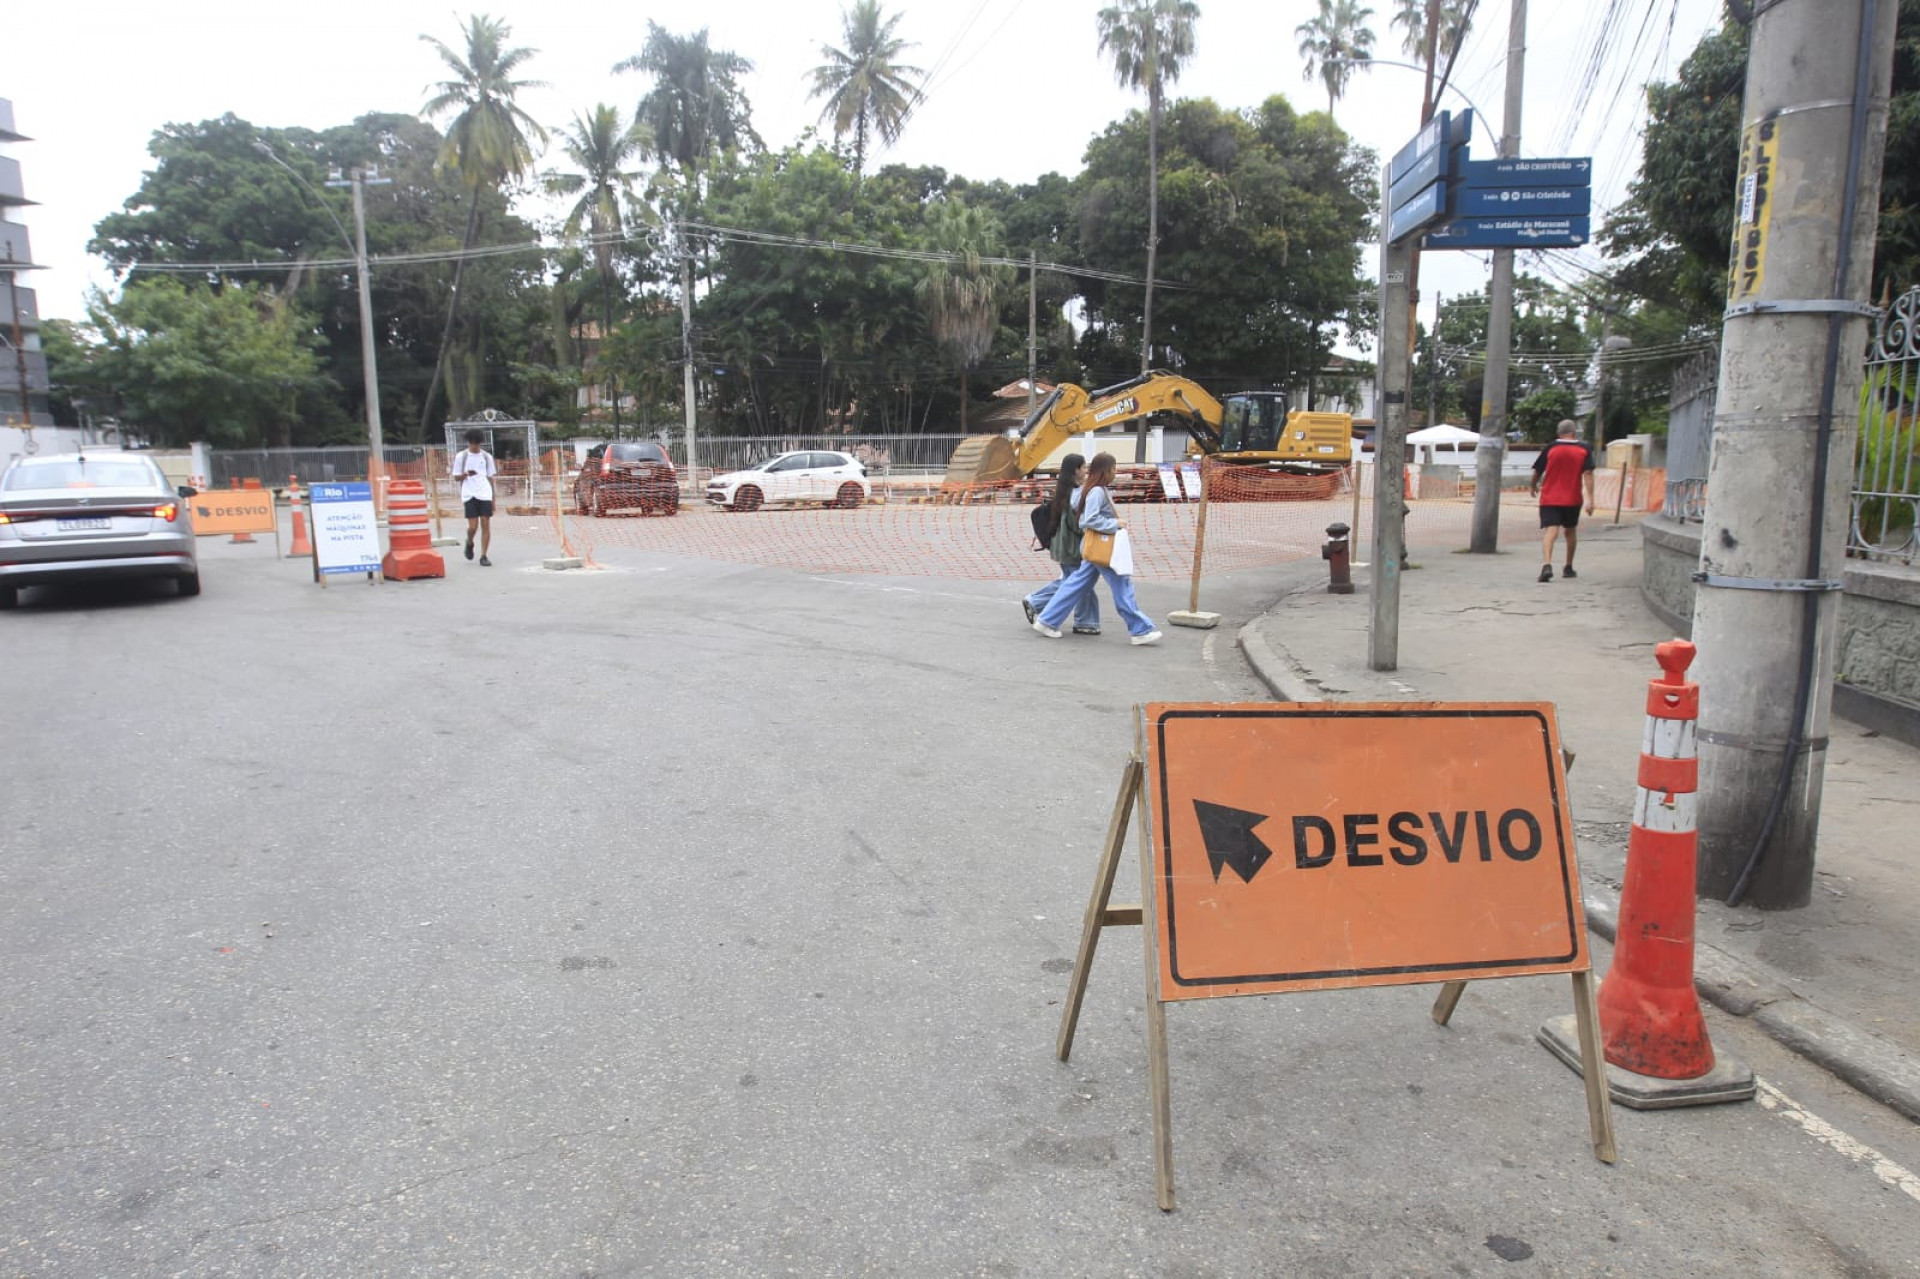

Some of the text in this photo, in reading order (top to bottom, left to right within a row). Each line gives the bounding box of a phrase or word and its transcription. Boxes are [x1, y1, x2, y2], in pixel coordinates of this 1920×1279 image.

[1515, 161, 1530, 170] SÃO
[1531, 161, 1572, 170] CRISTÓVÃO
[1495, 220, 1522, 229] Estádio
[1116, 396, 1135, 414] CAT
[324, 488, 343, 497] Rio
[215, 506, 268, 517] DESVIO
[327, 513, 363, 521] ATENÇÃO
[1291, 807, 1543, 870] DESVIO
